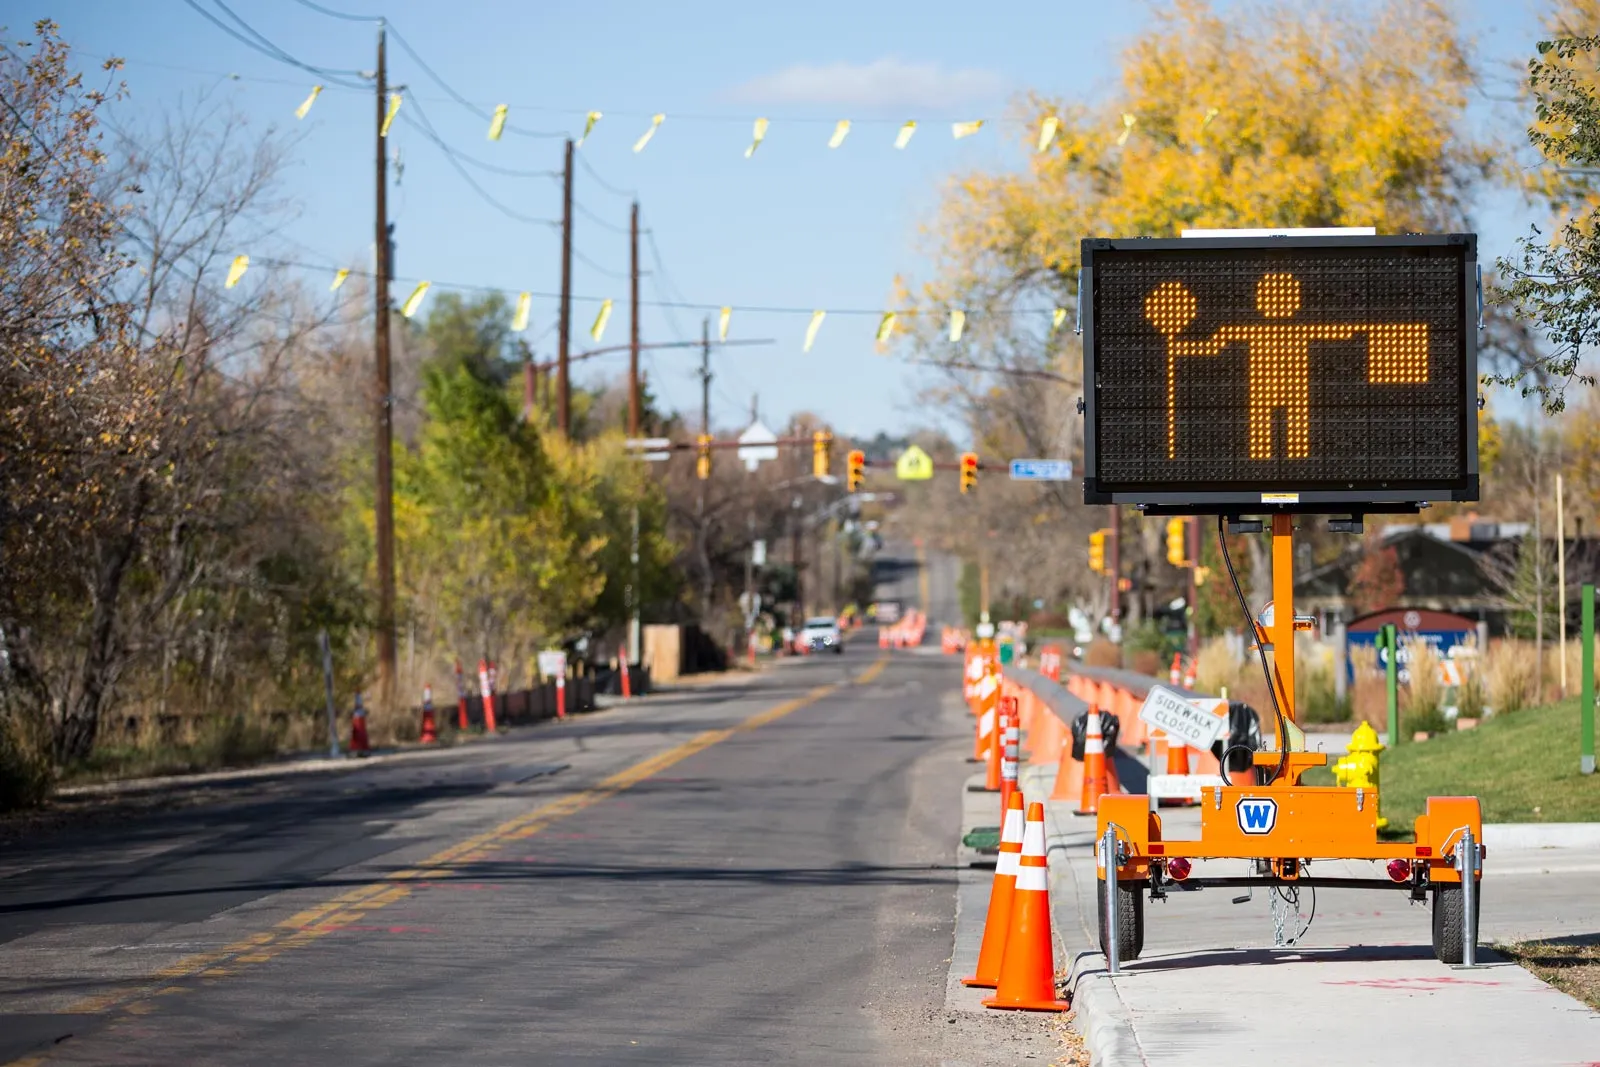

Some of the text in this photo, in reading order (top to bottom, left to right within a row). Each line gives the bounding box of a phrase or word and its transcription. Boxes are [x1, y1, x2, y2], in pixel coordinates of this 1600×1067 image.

[1155, 695, 1214, 730] SIDEWALK
[1155, 710, 1200, 740] CLOSED
[1243, 805, 1271, 828] W
